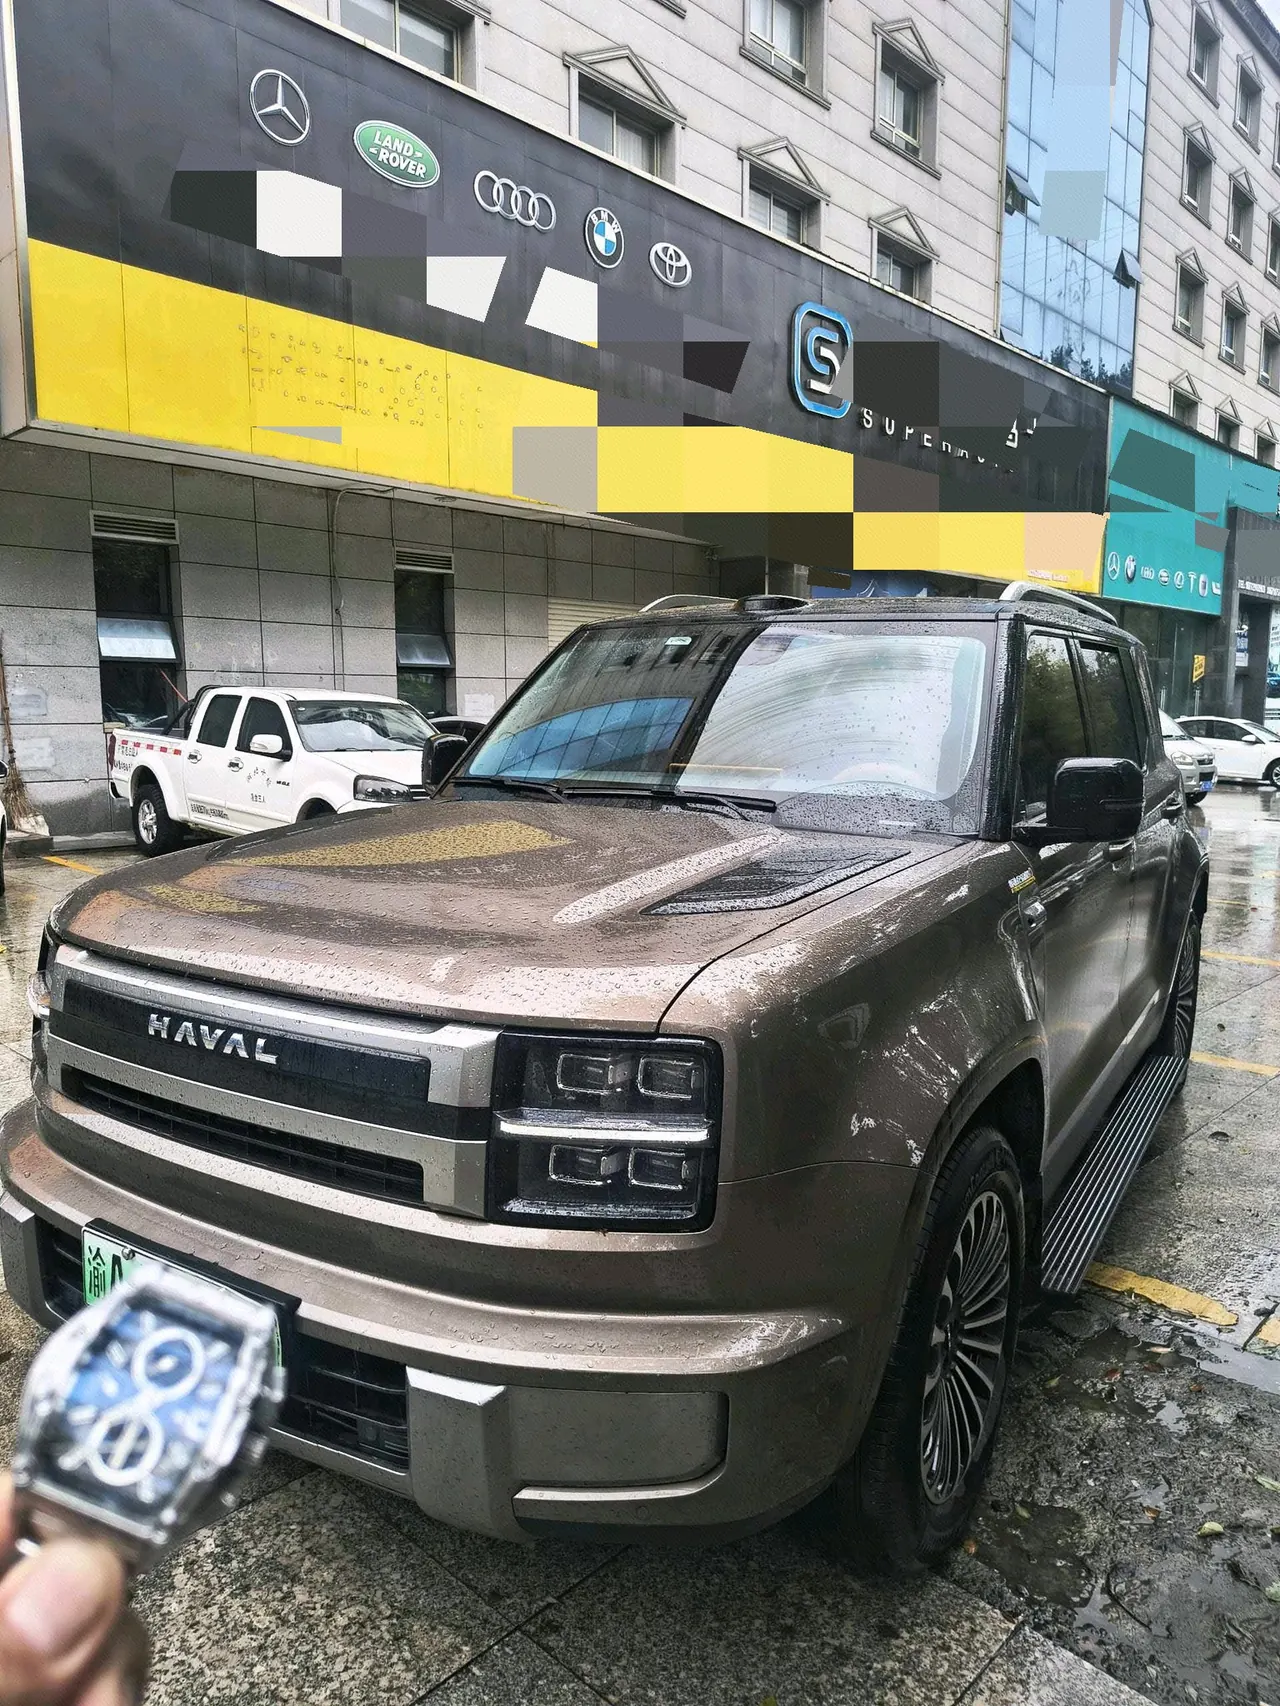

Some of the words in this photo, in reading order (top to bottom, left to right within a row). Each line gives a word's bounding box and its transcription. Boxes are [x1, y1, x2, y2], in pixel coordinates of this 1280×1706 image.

[373, 129, 414, 157] LAND
[377, 147, 426, 179] ROVER
[590, 210, 621, 233] BMW
[148, 1013, 279, 1065] HAVAL
